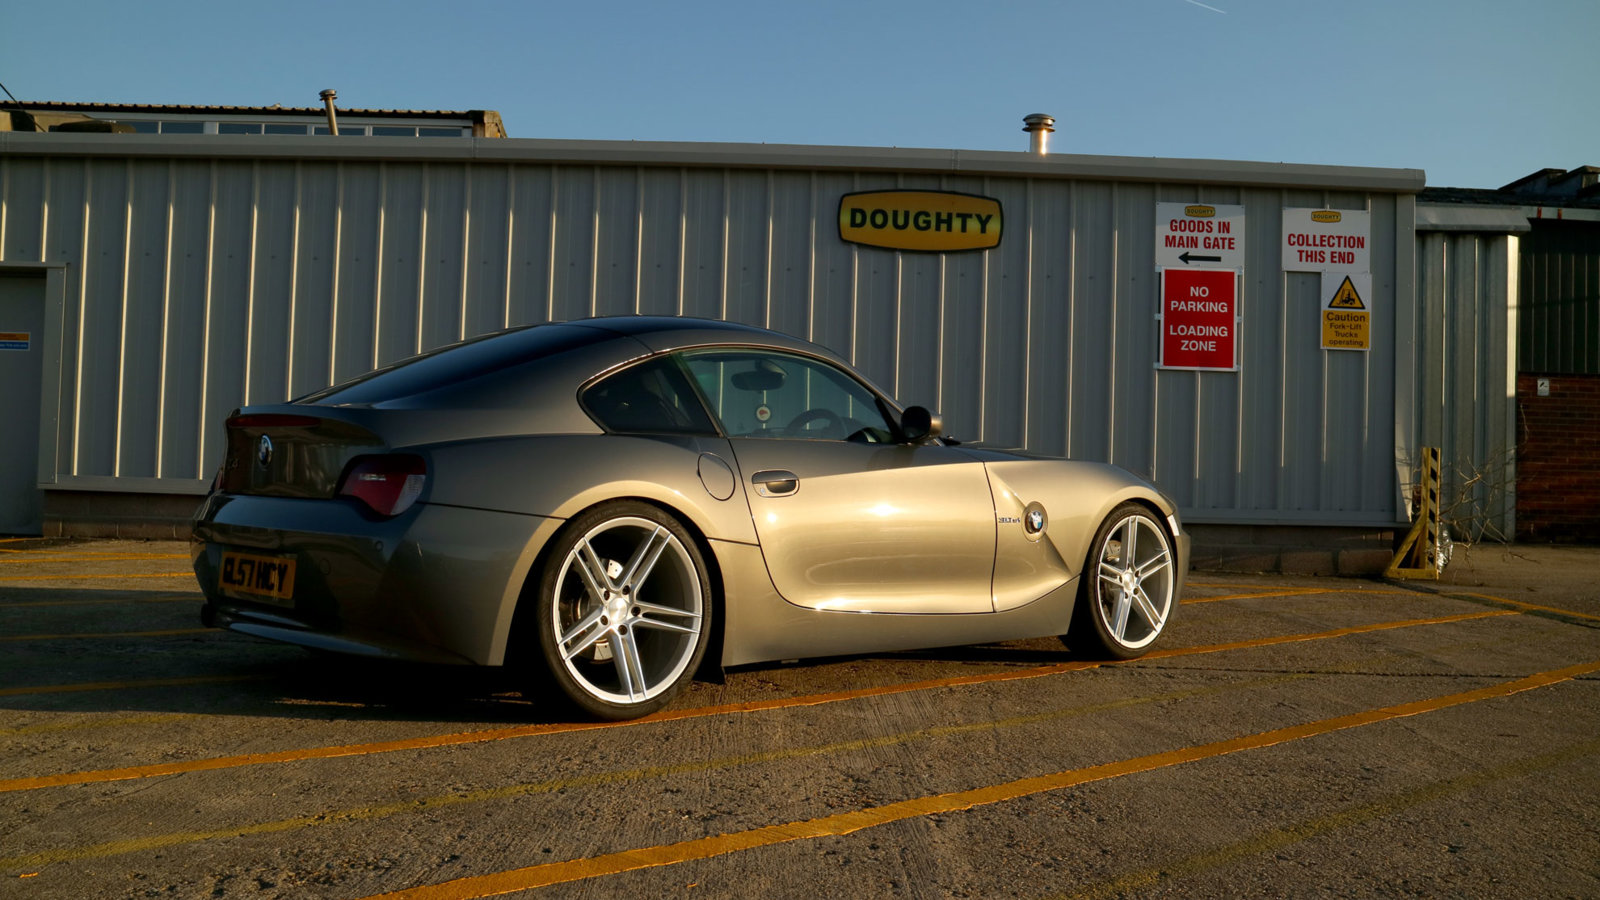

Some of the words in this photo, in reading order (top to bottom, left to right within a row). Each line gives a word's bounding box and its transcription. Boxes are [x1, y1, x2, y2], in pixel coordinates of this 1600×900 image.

[849, 207, 993, 234] DOUGHTY
[1169, 218, 1214, 234] GOODS
[1218, 221, 1231, 234] IN
[1164, 235, 1199, 249] MAIN
[1203, 236, 1236, 250] GATE
[1287, 233, 1365, 249] COLLECTION
[1297, 250, 1326, 263] THIS
[1330, 251, 1355, 264] END
[1190, 286, 1209, 297] NO
[1170, 300, 1228, 313] PARKING
[1326, 311, 1366, 322] Caution
[1169, 324, 1228, 337] LOADING
[1329, 322, 1362, 330] Fork-Lift
[1334, 330, 1359, 338] Trucks
[1180, 340, 1217, 352] ZONE
[1328, 338, 1364, 347] operating
